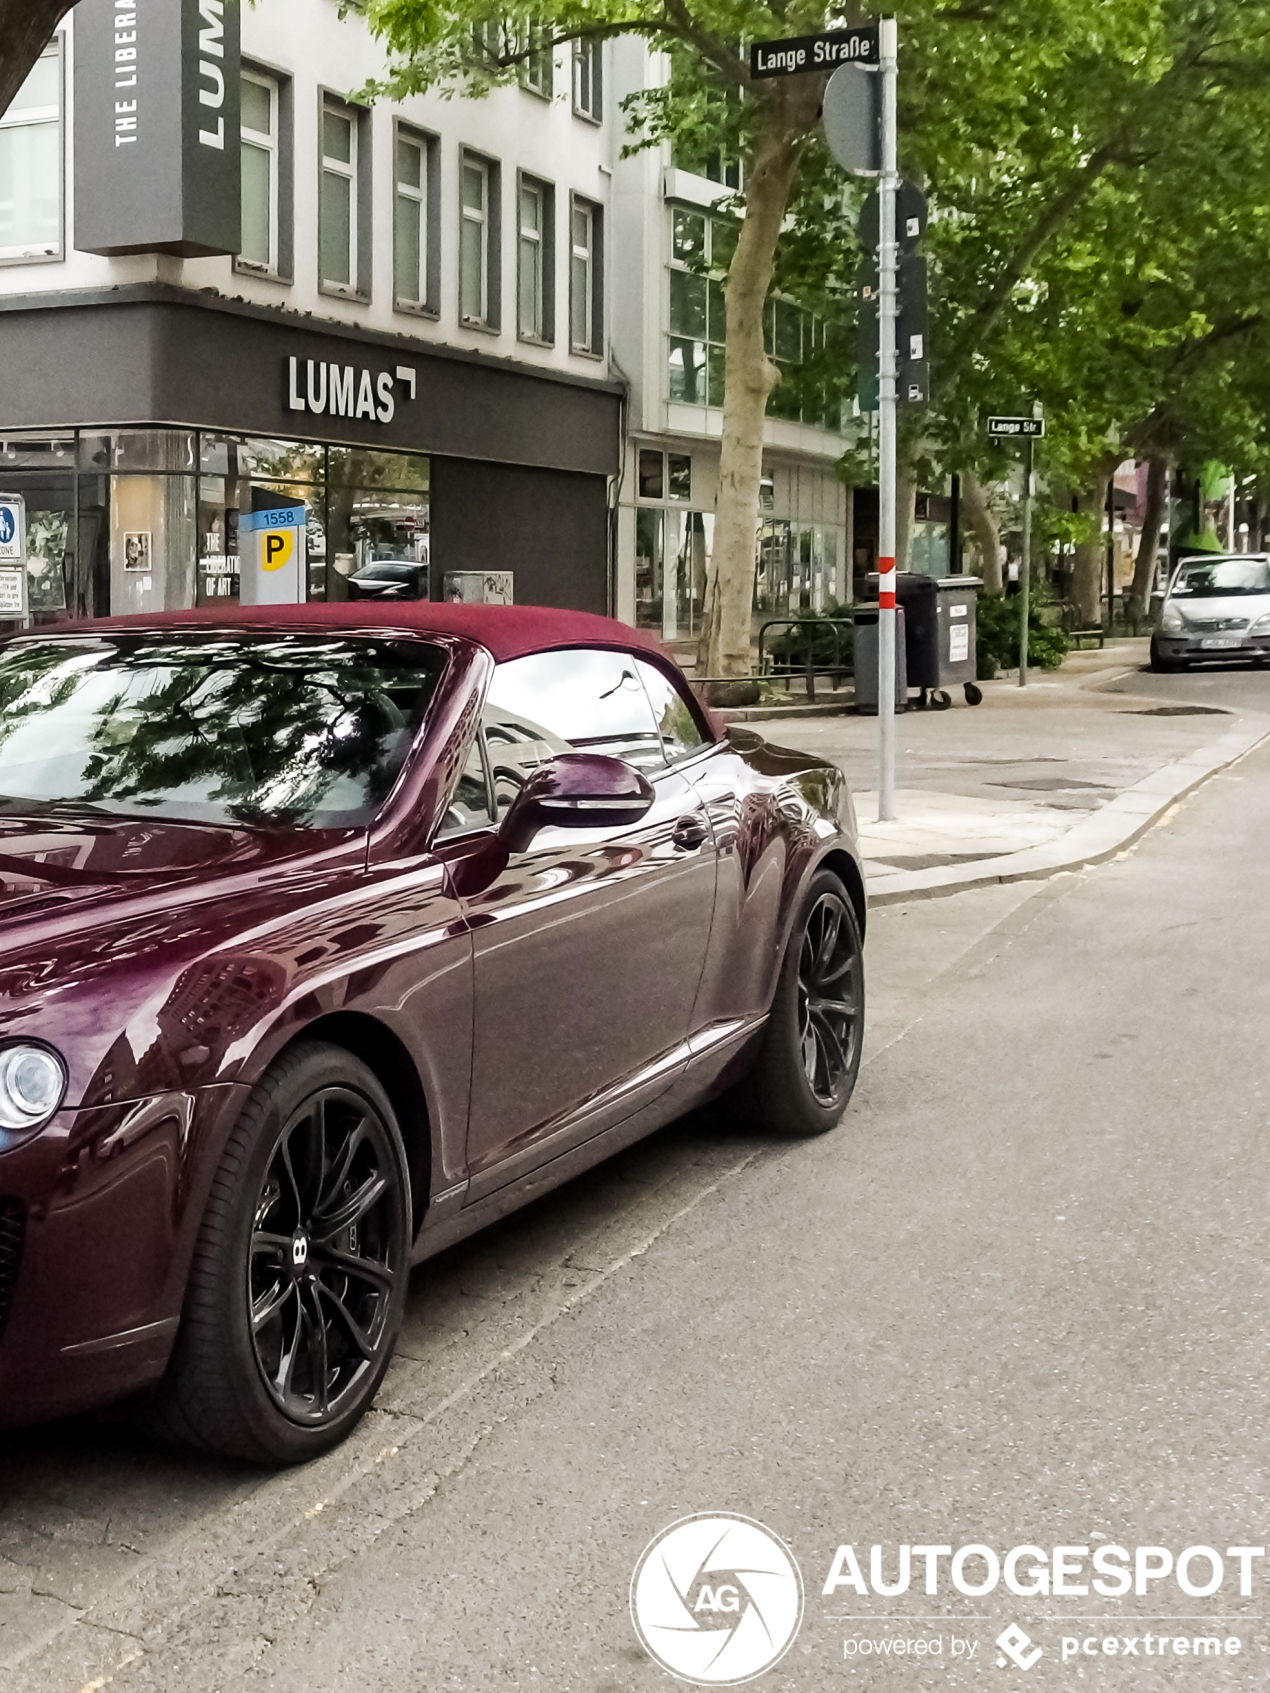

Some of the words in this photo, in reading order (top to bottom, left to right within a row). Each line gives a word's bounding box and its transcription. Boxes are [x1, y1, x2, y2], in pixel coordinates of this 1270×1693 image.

[757, 49, 806, 72] Lange
[813, 36, 870, 62] Straße
[115, 99, 137, 147] THE
[289, 355, 395, 424] LUMAS
[991, 420, 1020, 434] Lange
[264, 511, 295, 525] 1558
[206, 532, 220, 551] THE
[266, 535, 285, 564] P
[206, 577, 216, 597] OF
[217, 577, 232, 596] ART
